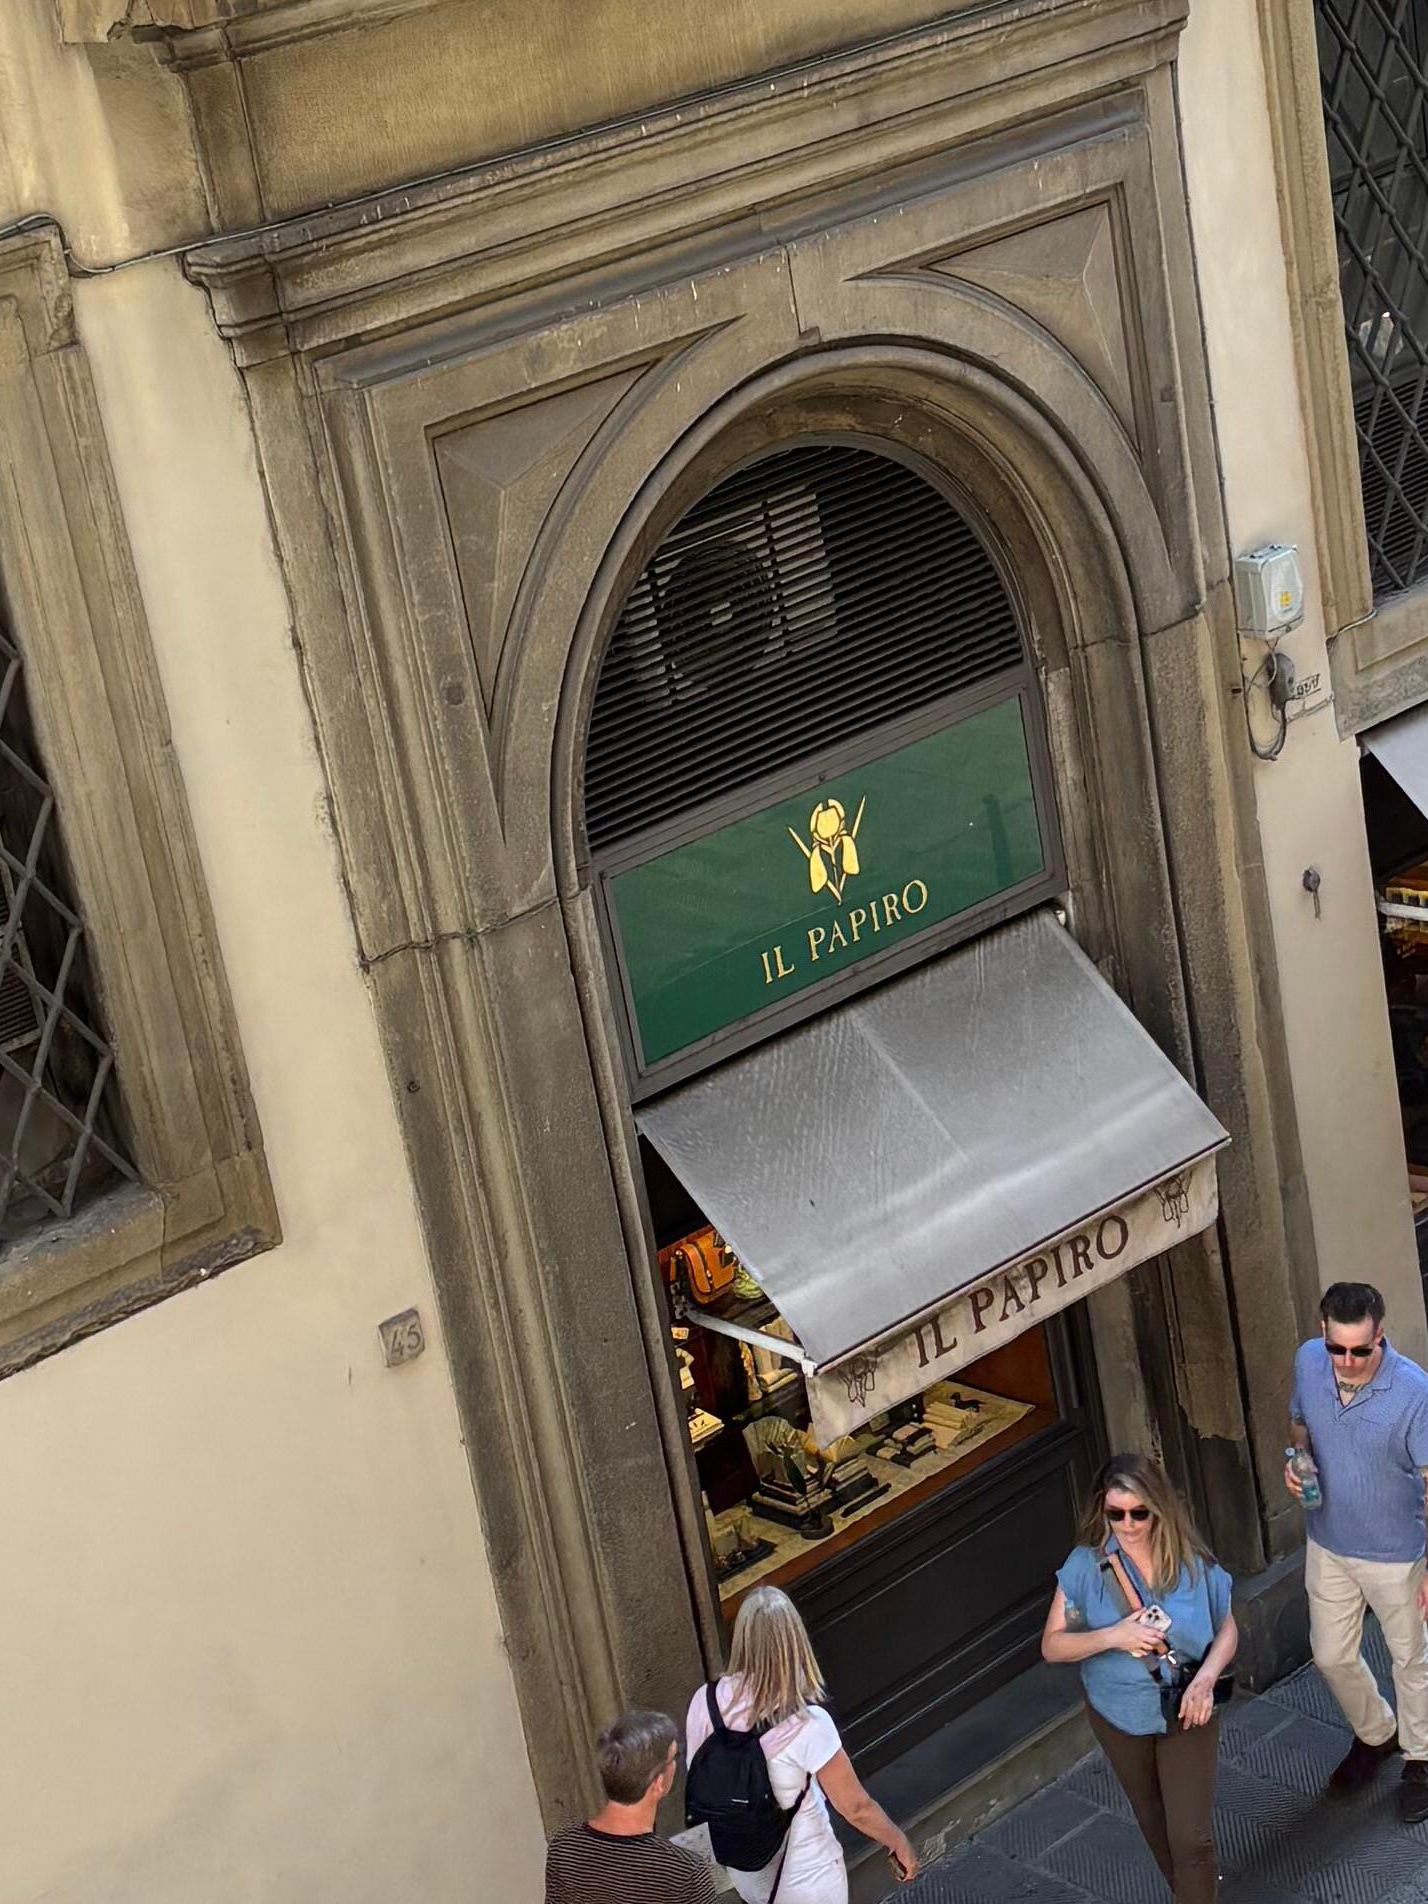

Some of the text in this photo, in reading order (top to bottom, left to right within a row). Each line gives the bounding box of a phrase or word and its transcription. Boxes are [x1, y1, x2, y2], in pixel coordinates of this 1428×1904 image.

[762, 879, 931, 985] IL PAPIRO
[915, 1214, 1130, 1369] IL PAPIRO
